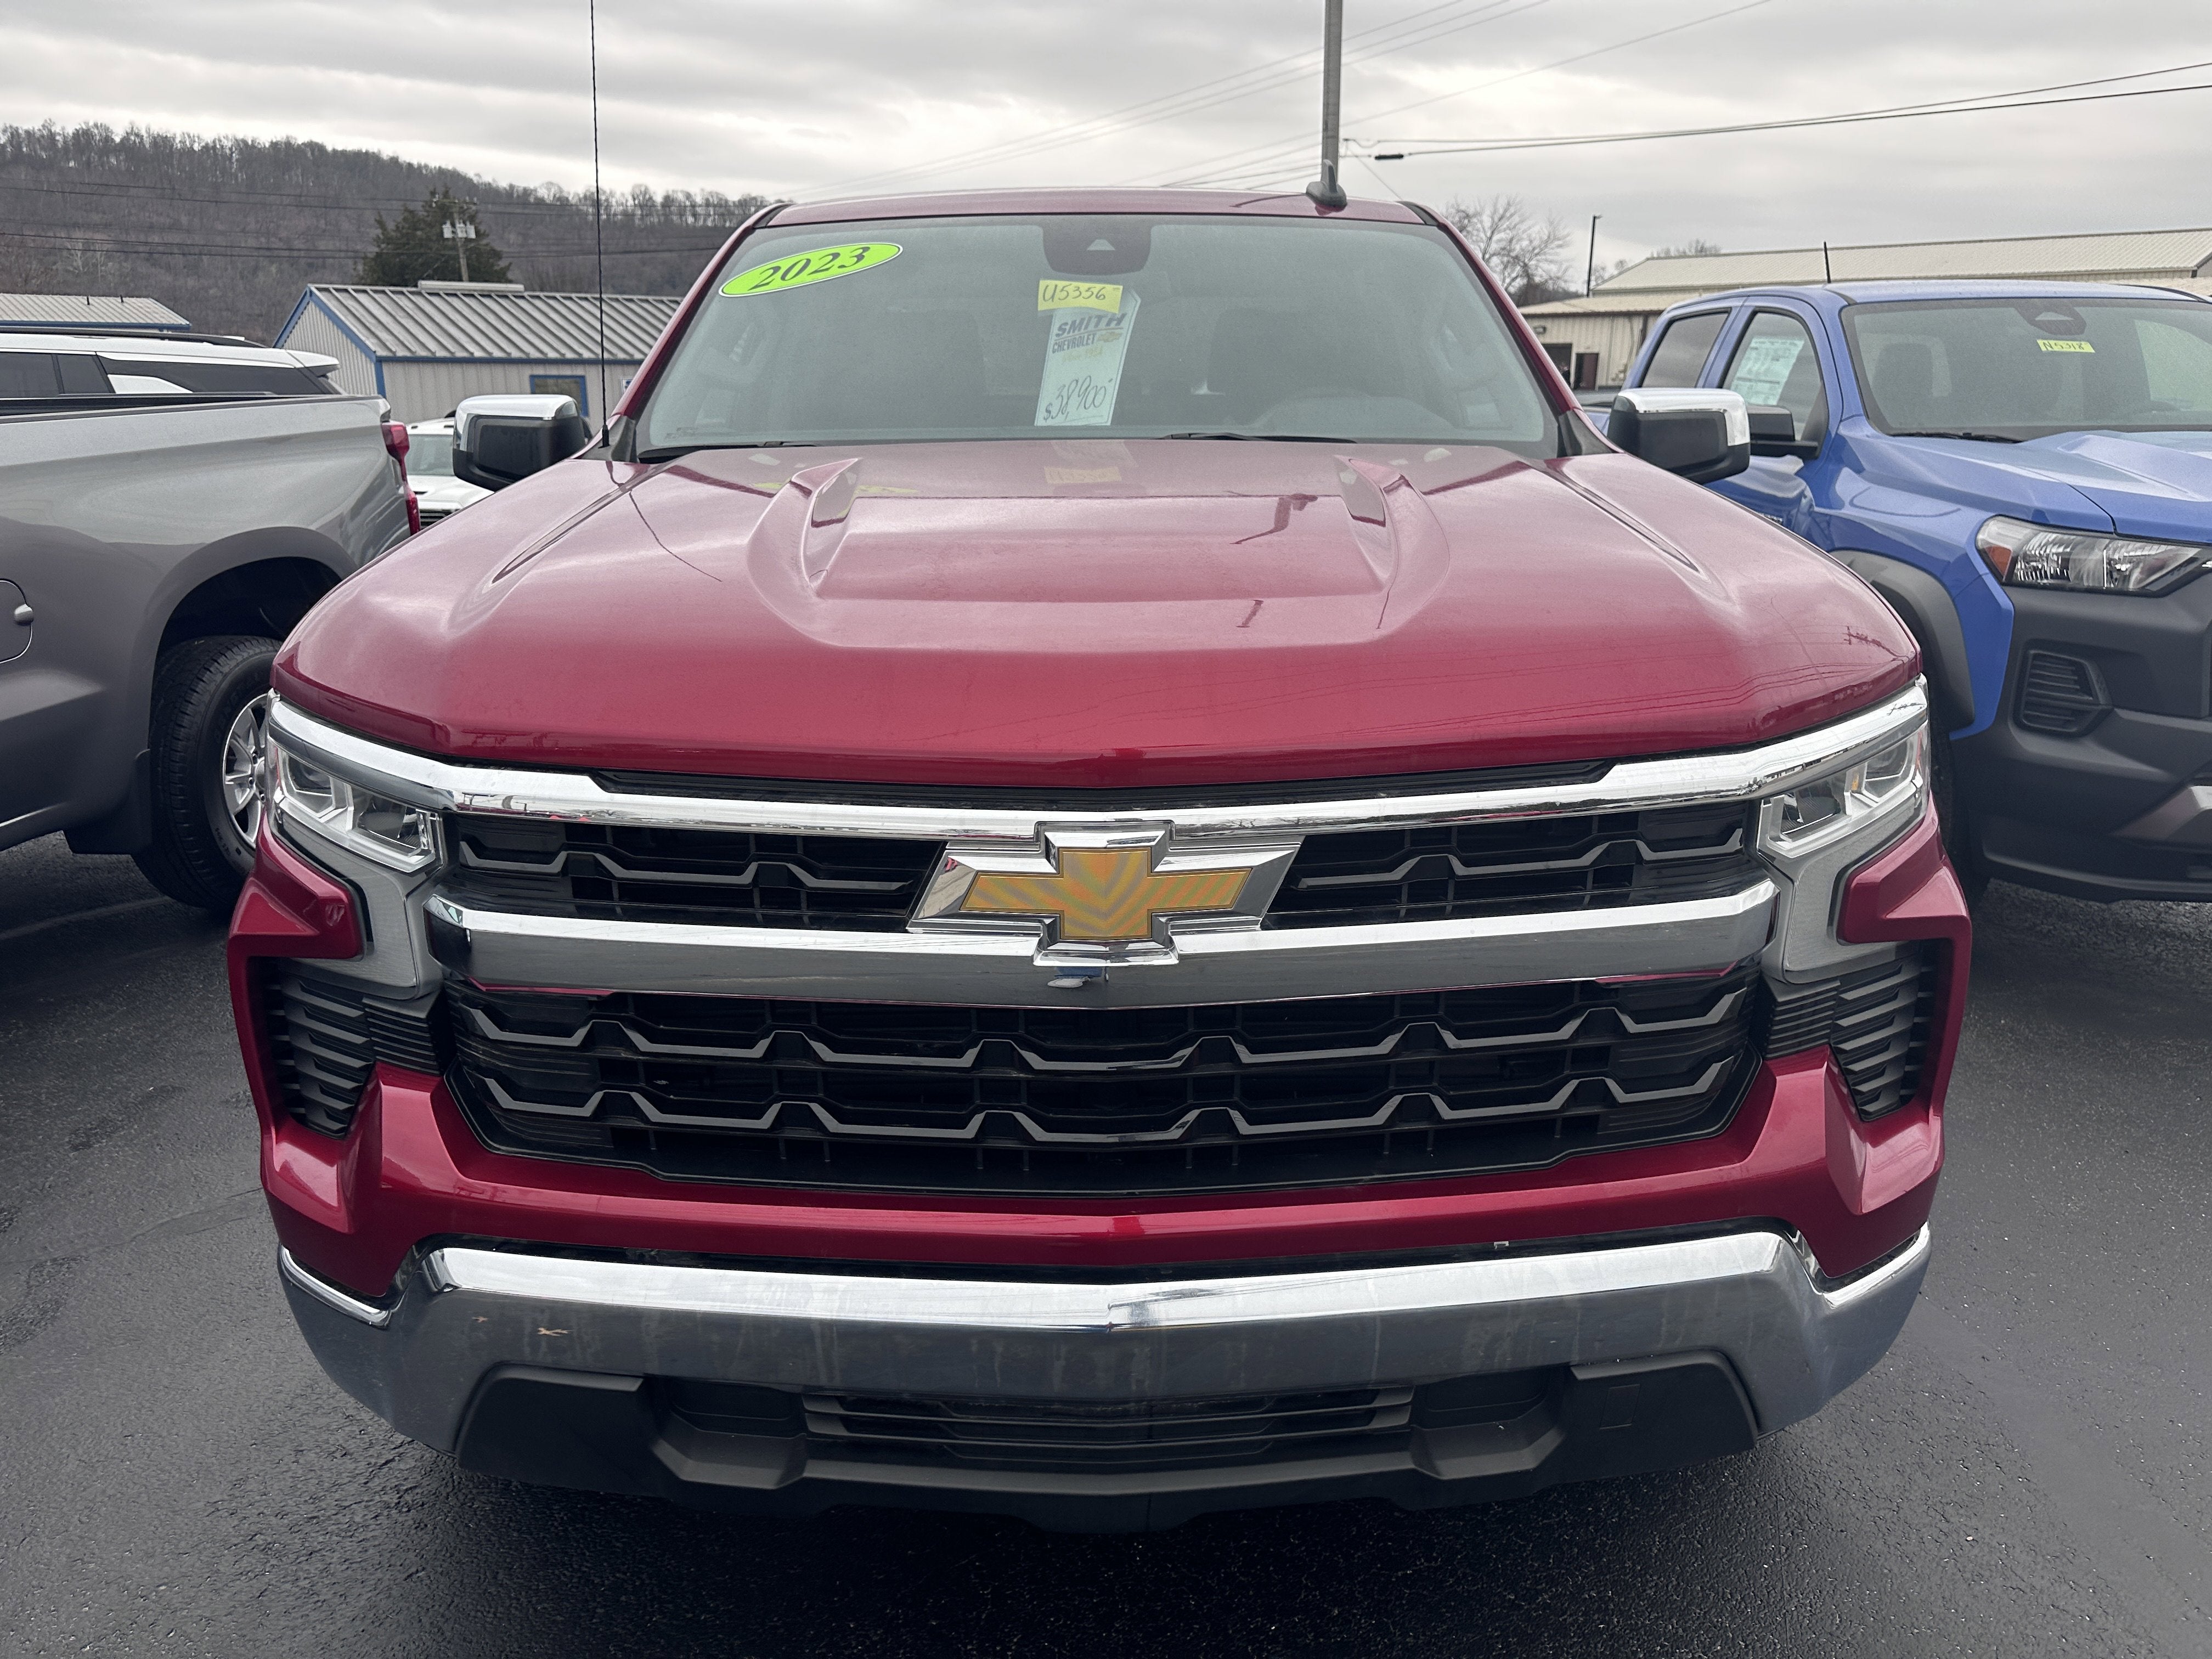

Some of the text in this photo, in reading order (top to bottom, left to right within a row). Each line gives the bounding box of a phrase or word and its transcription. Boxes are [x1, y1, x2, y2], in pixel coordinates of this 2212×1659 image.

[747, 246, 871, 291] 2023
[1042, 284, 1106, 302] U5356
[1055, 313, 1127, 337] SMITH
[1052, 333, 1097, 354] CHEVROLET
